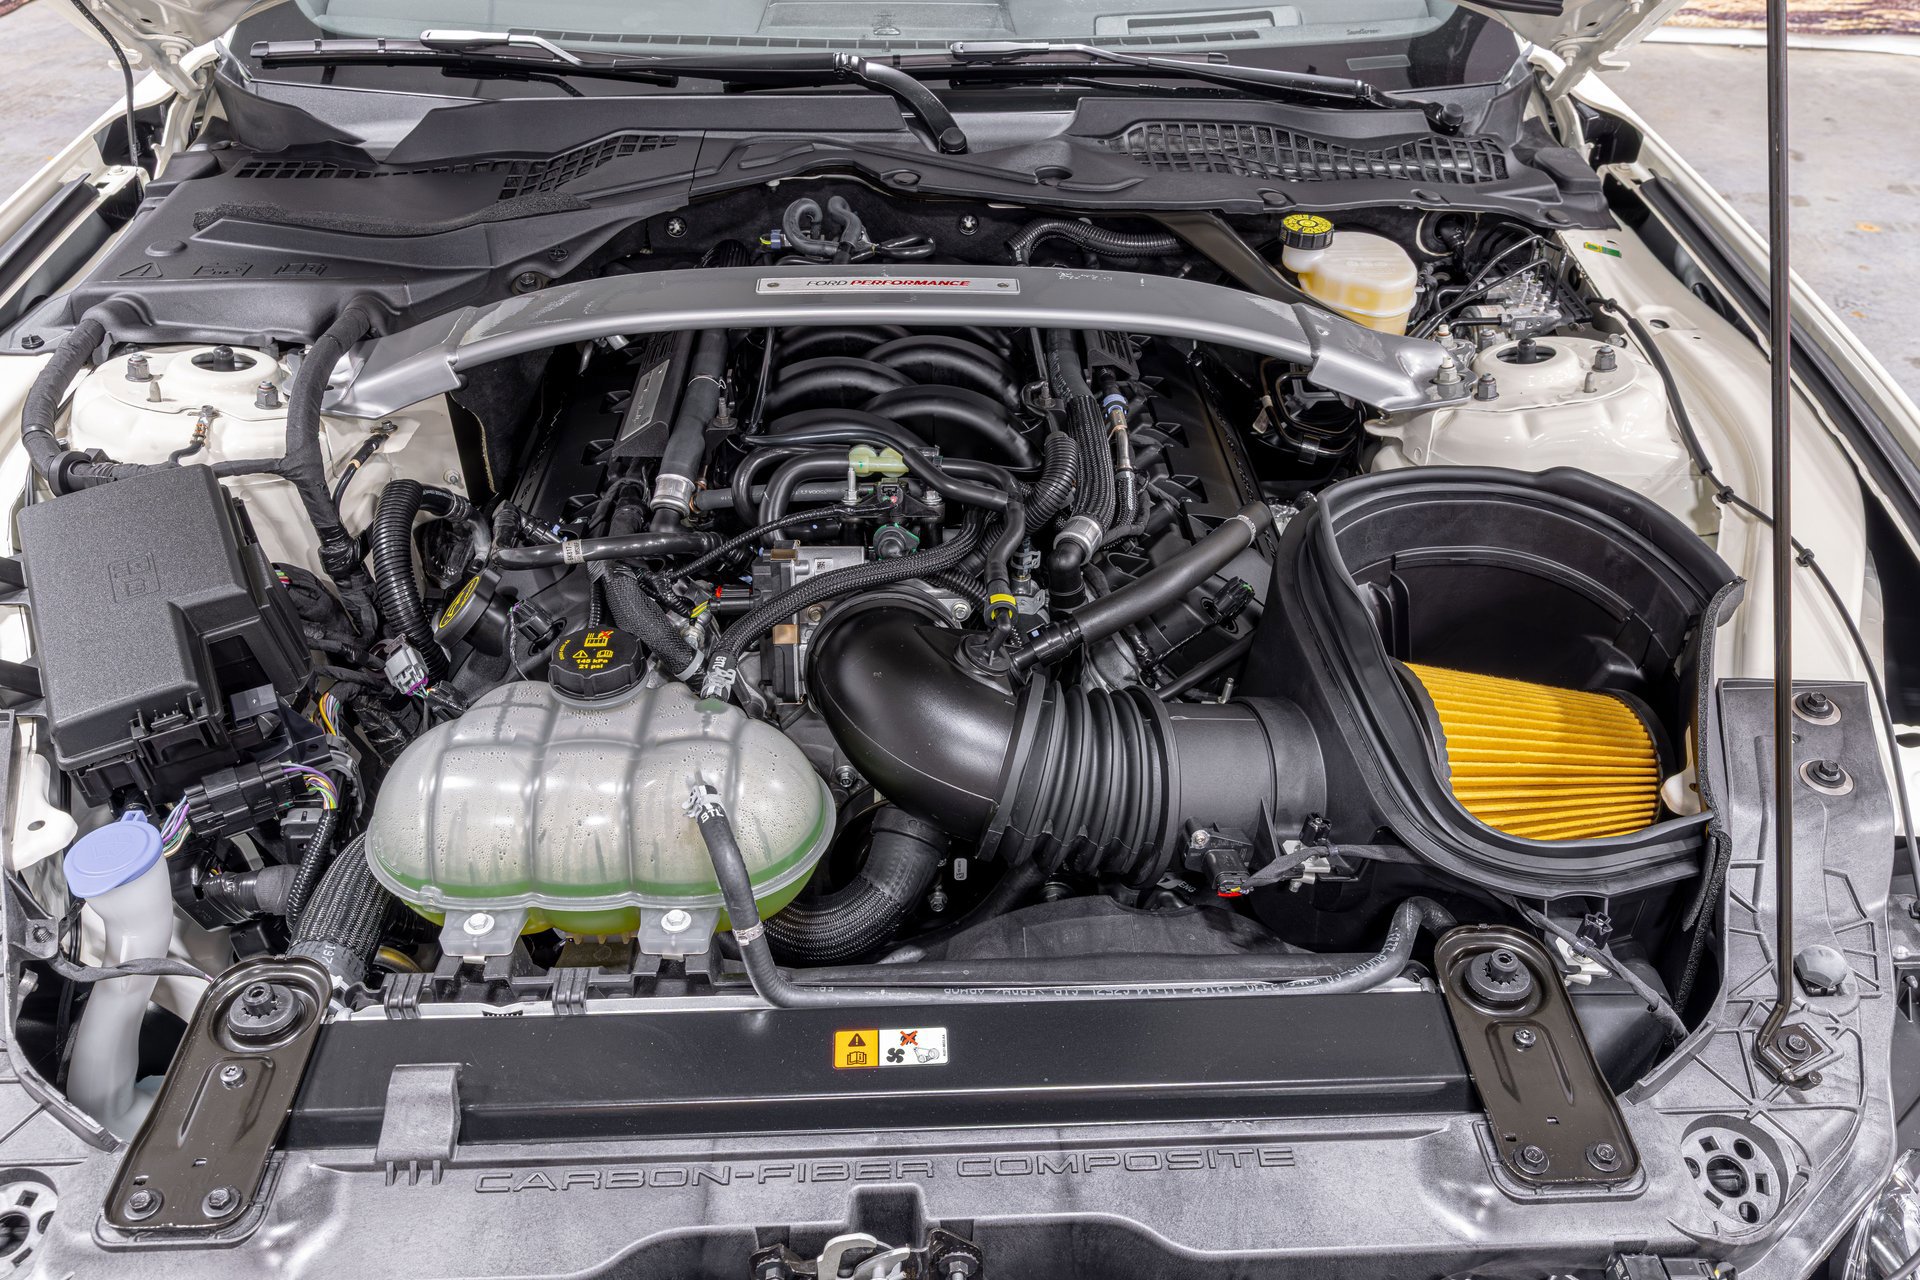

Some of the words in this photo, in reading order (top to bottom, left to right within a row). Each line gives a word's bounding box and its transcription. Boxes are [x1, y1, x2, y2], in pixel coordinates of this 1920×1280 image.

[700, 808, 724, 823] BTL
[474, 1158, 934, 1194] CARBON-FIBER
[956, 1146, 1295, 1178] COMPOSITE
